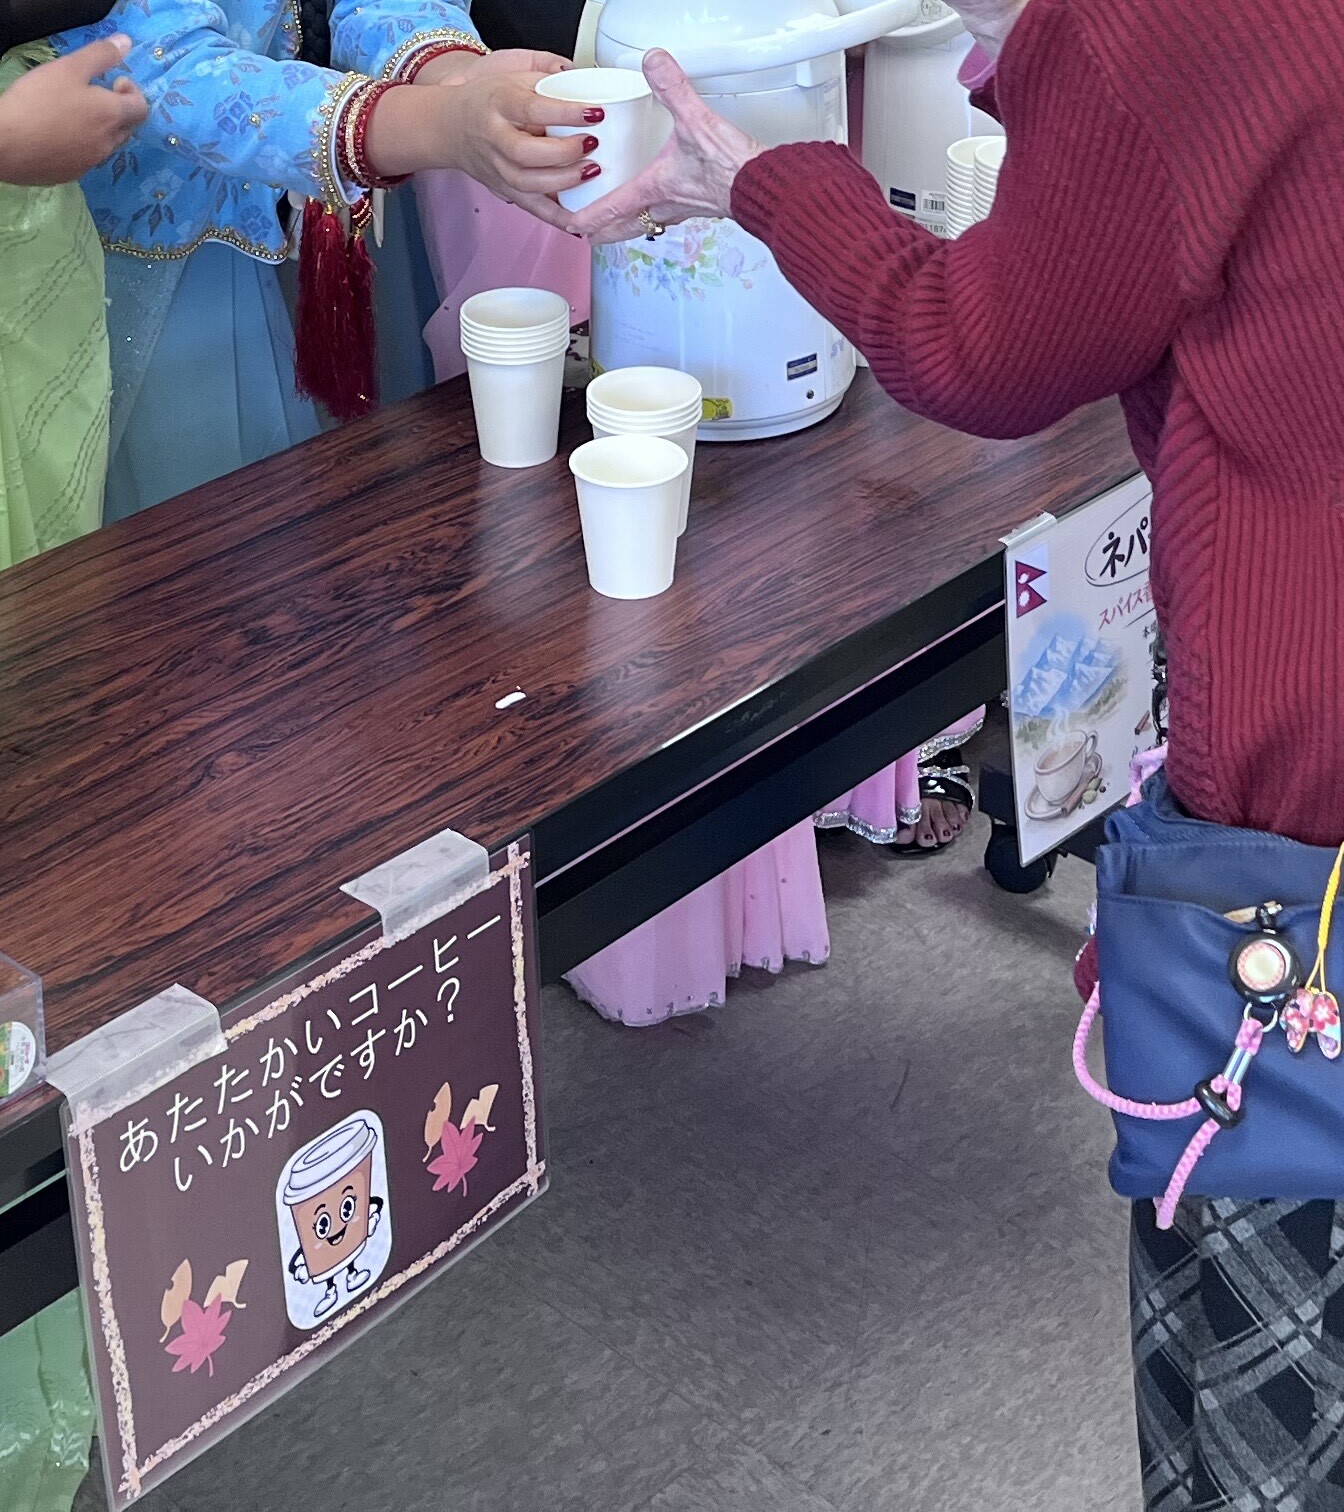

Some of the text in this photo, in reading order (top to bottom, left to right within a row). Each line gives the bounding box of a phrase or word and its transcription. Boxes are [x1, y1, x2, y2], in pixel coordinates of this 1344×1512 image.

[1099, 516, 1151, 577] ネパ
[117, 914, 503, 1175] あたたかいコーヒー
[175, 976, 461, 1192] いかがですか？
